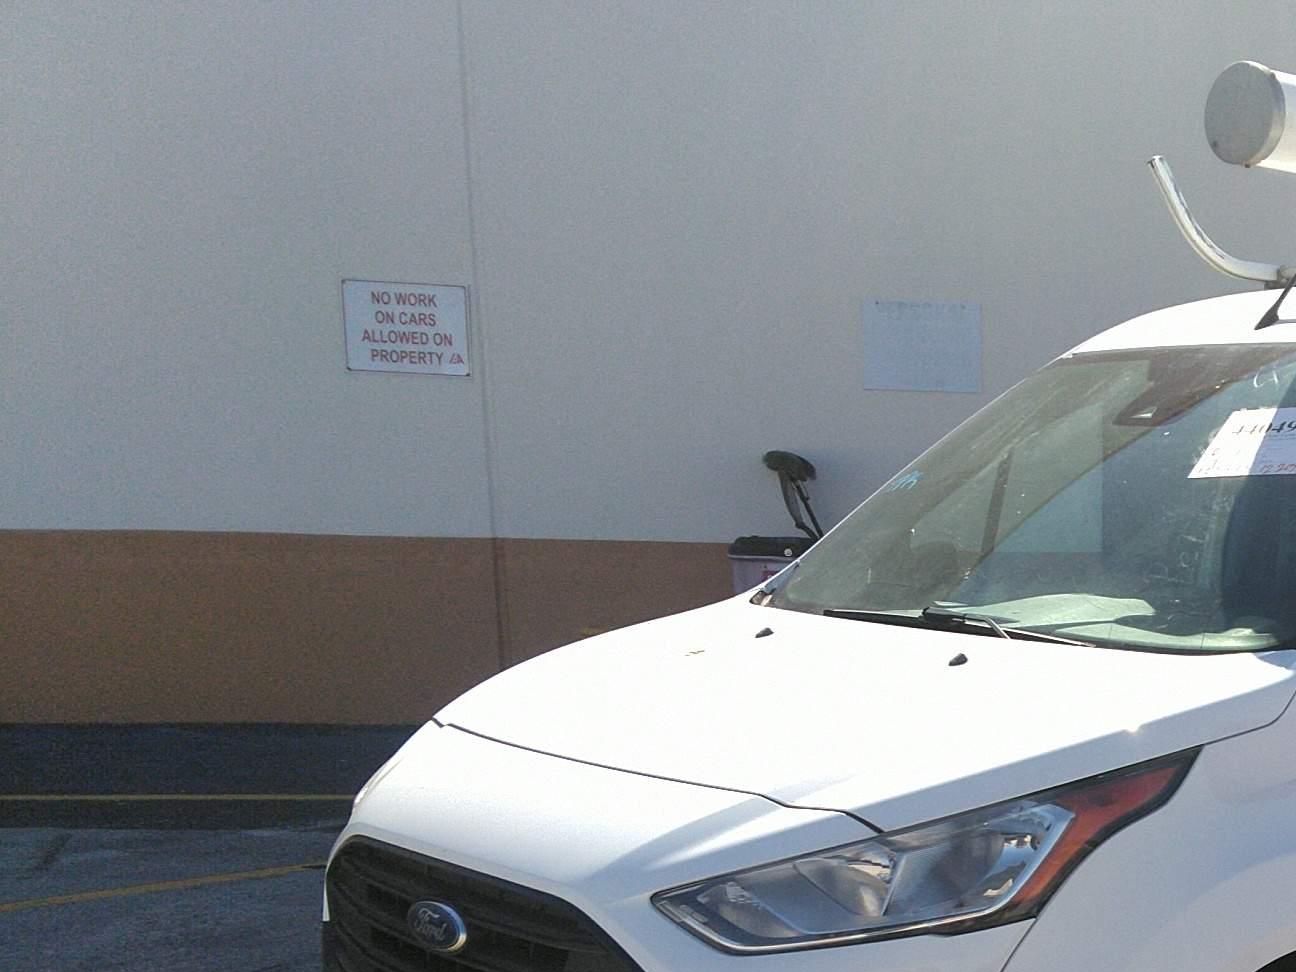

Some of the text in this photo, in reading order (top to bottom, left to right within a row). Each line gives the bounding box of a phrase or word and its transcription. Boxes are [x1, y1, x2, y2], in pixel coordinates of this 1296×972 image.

[371, 291, 437, 308] NO WORK
[375, 310, 436, 327] ON CARS
[362, 328, 453, 346] ALLOWED ON
[370, 349, 444, 366] PROPERTY
[413, 907, 448, 942] Ford
